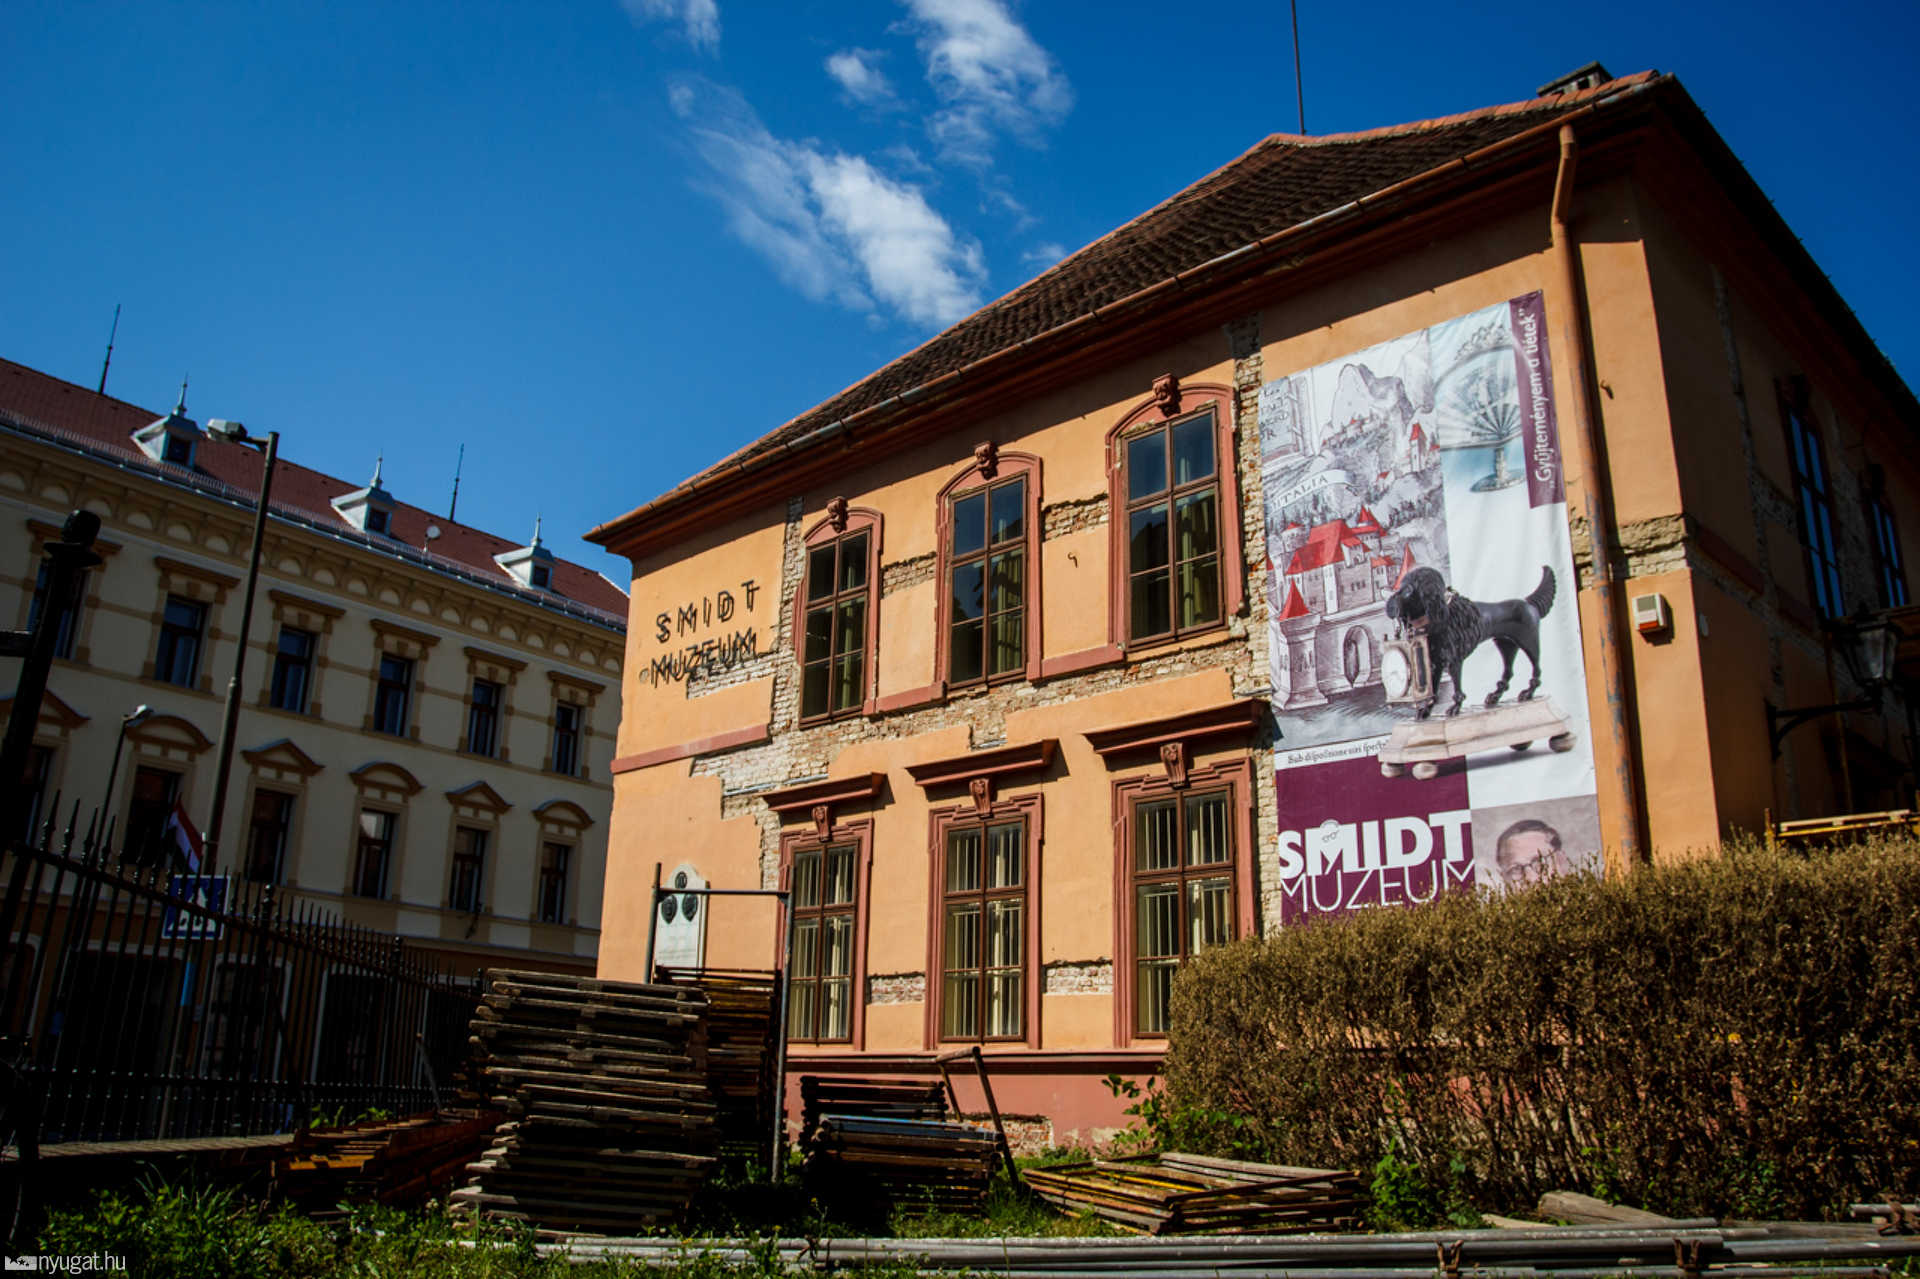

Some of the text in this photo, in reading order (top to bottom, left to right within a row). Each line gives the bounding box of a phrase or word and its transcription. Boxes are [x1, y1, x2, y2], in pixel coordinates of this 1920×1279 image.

[1528, 358, 1541, 369] a
[656, 580, 759, 643] SMIDT
[651, 627, 757, 688] MUZEUM
[1278, 810, 1472, 880] SMIDT
[1281, 858, 1476, 913] MUZEUM
